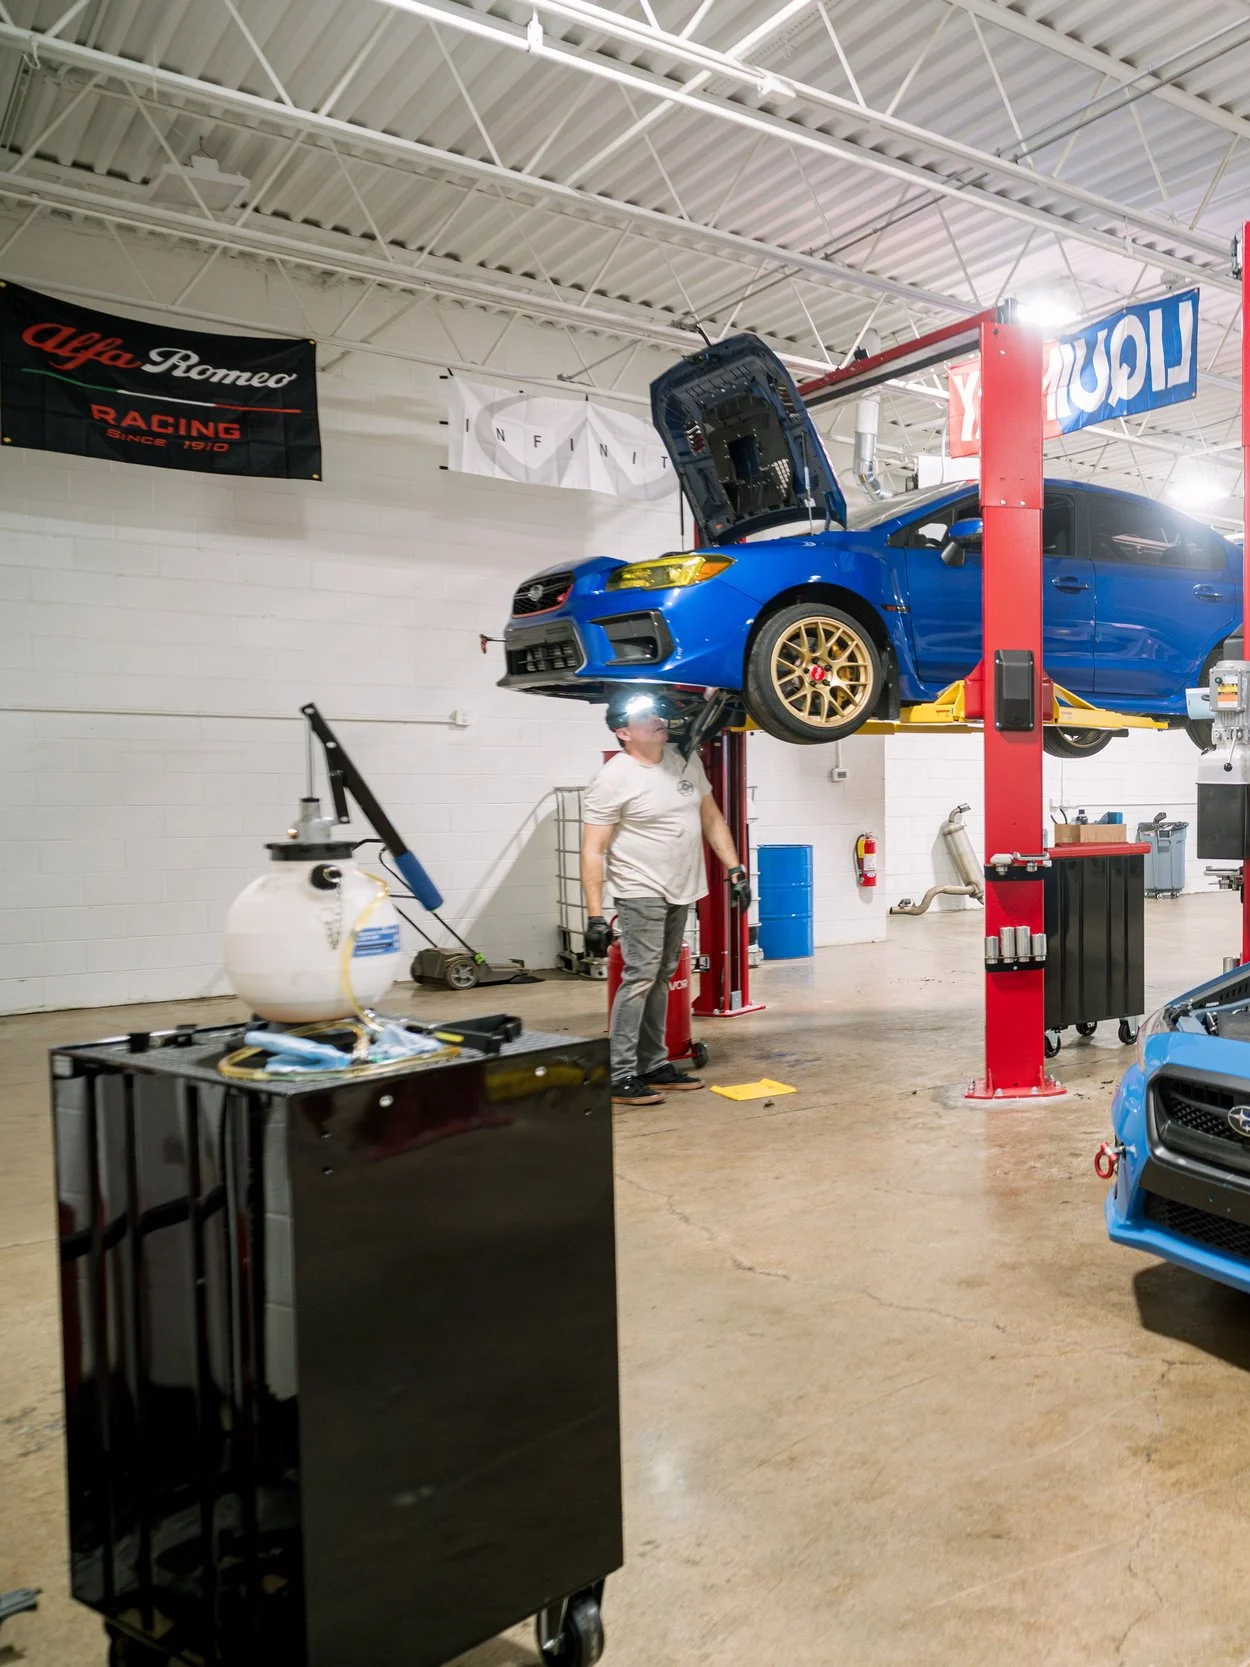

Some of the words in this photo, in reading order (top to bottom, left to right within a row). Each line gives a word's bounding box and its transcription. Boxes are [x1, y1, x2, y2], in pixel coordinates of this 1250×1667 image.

[22, 322, 143, 371] Alfa
[141, 347, 298, 389] Romeo
[90, 403, 242, 440] RACING
[106, 428, 169, 448] SINCE
[183, 440, 230, 453] 1910
[465, 418, 669, 469] INFINIT
[669, 979, 688, 991] VOR
